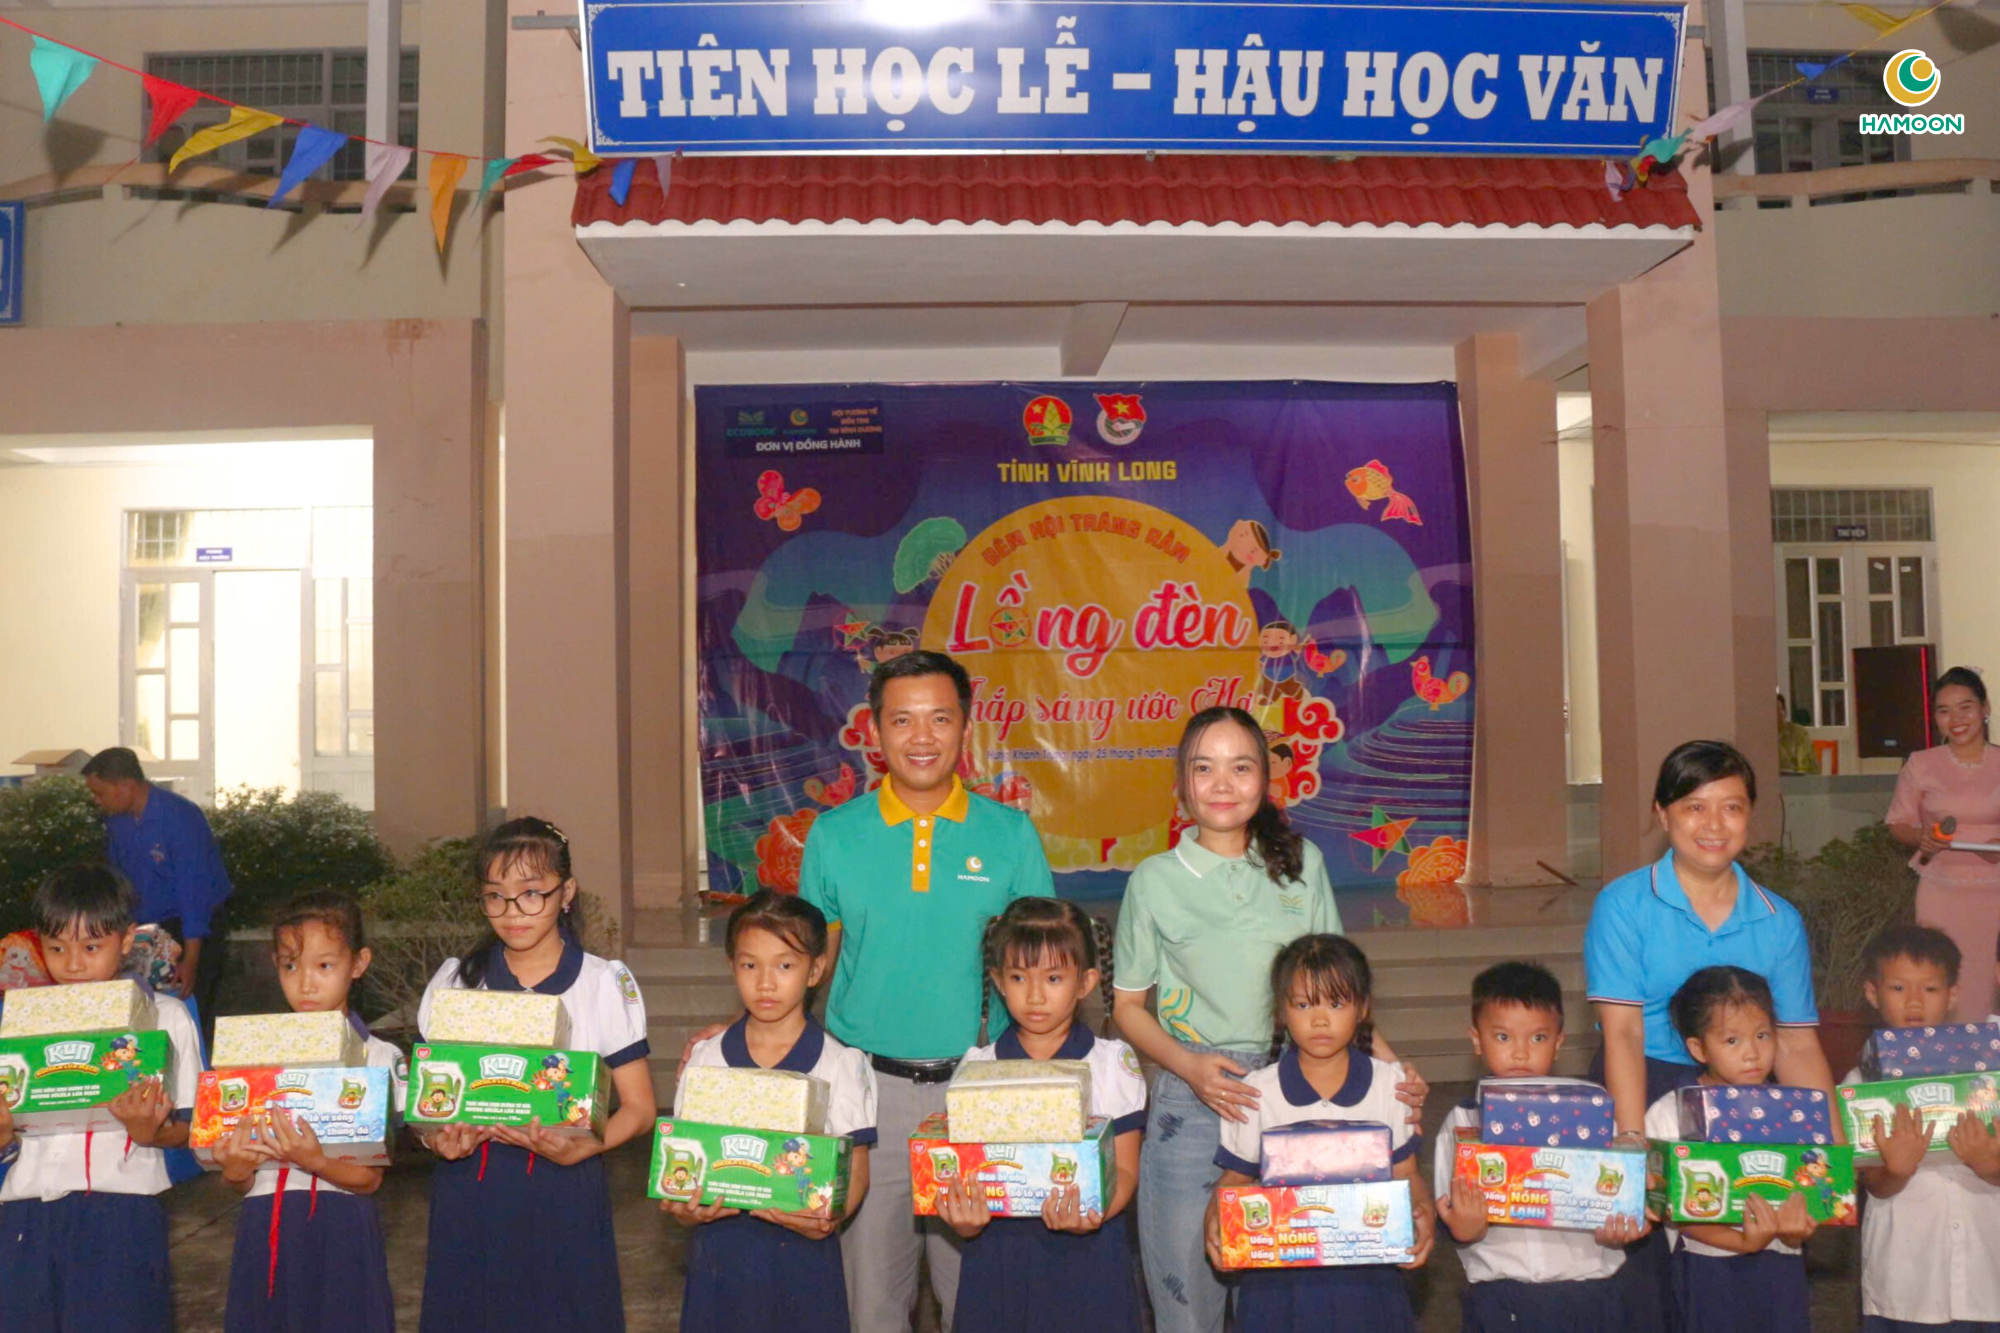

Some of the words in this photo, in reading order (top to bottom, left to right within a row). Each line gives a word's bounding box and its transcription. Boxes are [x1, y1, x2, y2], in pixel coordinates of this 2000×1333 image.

[607, 33, 790, 118] TIÊN
[812, 46, 975, 132] HỌC
[997, 15, 1090, 114] LỄ
[1173, 33, 1324, 133] HẬU
[1343, 51, 1499, 135] HỌC
[1518, 40, 1663, 123] VĂN
[756, 442, 781, 451] ĐƠN
[782, 441, 793, 452] VỊ
[830, 437, 861, 449] HÀNH
[997, 458, 1049, 482] TỈNH
[1056, 459, 1110, 482] VĨNH
[1118, 460, 1177, 481] LONG
[1029, 515, 1065, 540] HỘI
[1134, 580, 1250, 650] đèn
[1036, 693, 1117, 741] sáng
[1127, 692, 1182, 721] ước
[957, 874, 990, 882] HAMOON
[331, 1113, 354, 1124] sóng
[327, 1125, 354, 1137] thùng
[356, 1125, 369, 1135] đá
[977, 1172, 996, 1182] Bao
[1009, 1172, 1026, 1184] này
[1511, 1190, 1549, 1205] NÓNG
[1589, 1198, 1612, 1211] sóng
[1488, 1204, 1506, 1217] ống
[1510, 1205, 1546, 1220] LẠNH
[1250, 1233, 1274, 1246] Uống
[1278, 1231, 1317, 1244] NÓNG
[1358, 1231, 1381, 1244] sóng
[1251, 1248, 1275, 1261] Uống
[1279, 1247, 1316, 1262] LẠNH
